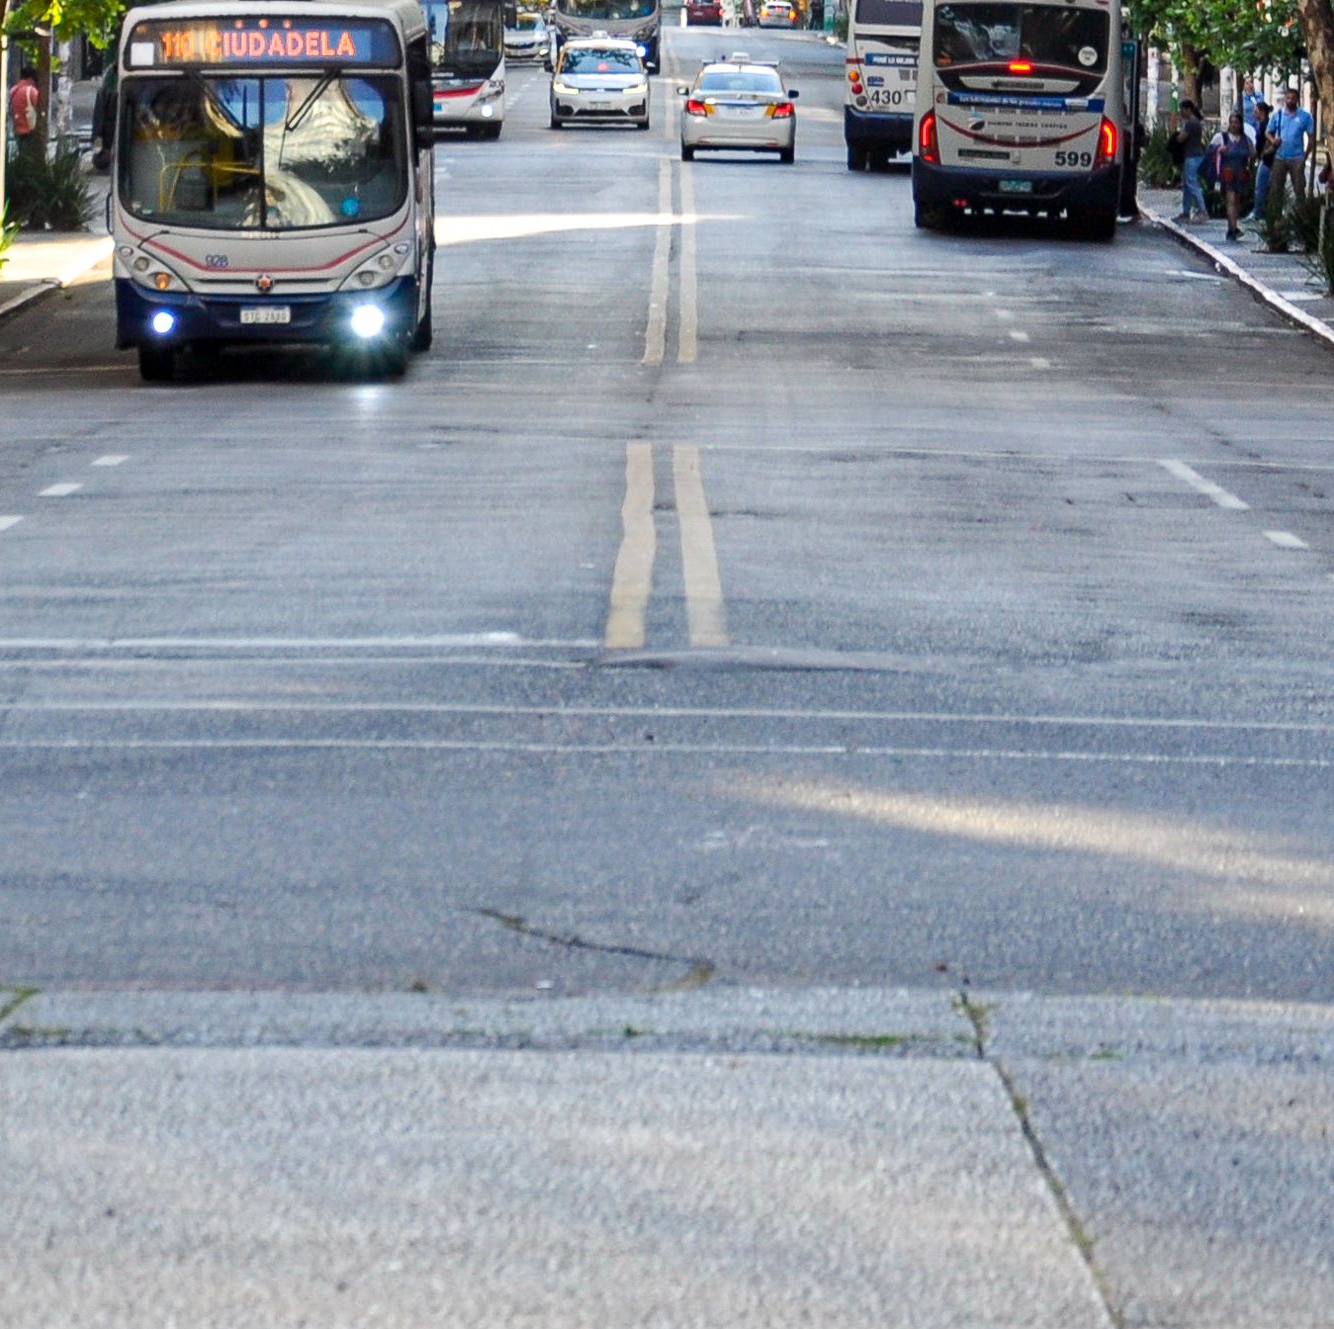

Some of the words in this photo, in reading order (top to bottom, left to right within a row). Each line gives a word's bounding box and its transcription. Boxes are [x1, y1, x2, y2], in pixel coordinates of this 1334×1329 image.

[162, 31, 196, 59] 110
[205, 31, 356, 57] CIUDADELA
[870, 89, 903, 106] 430
[1054, 150, 1093, 168] 599
